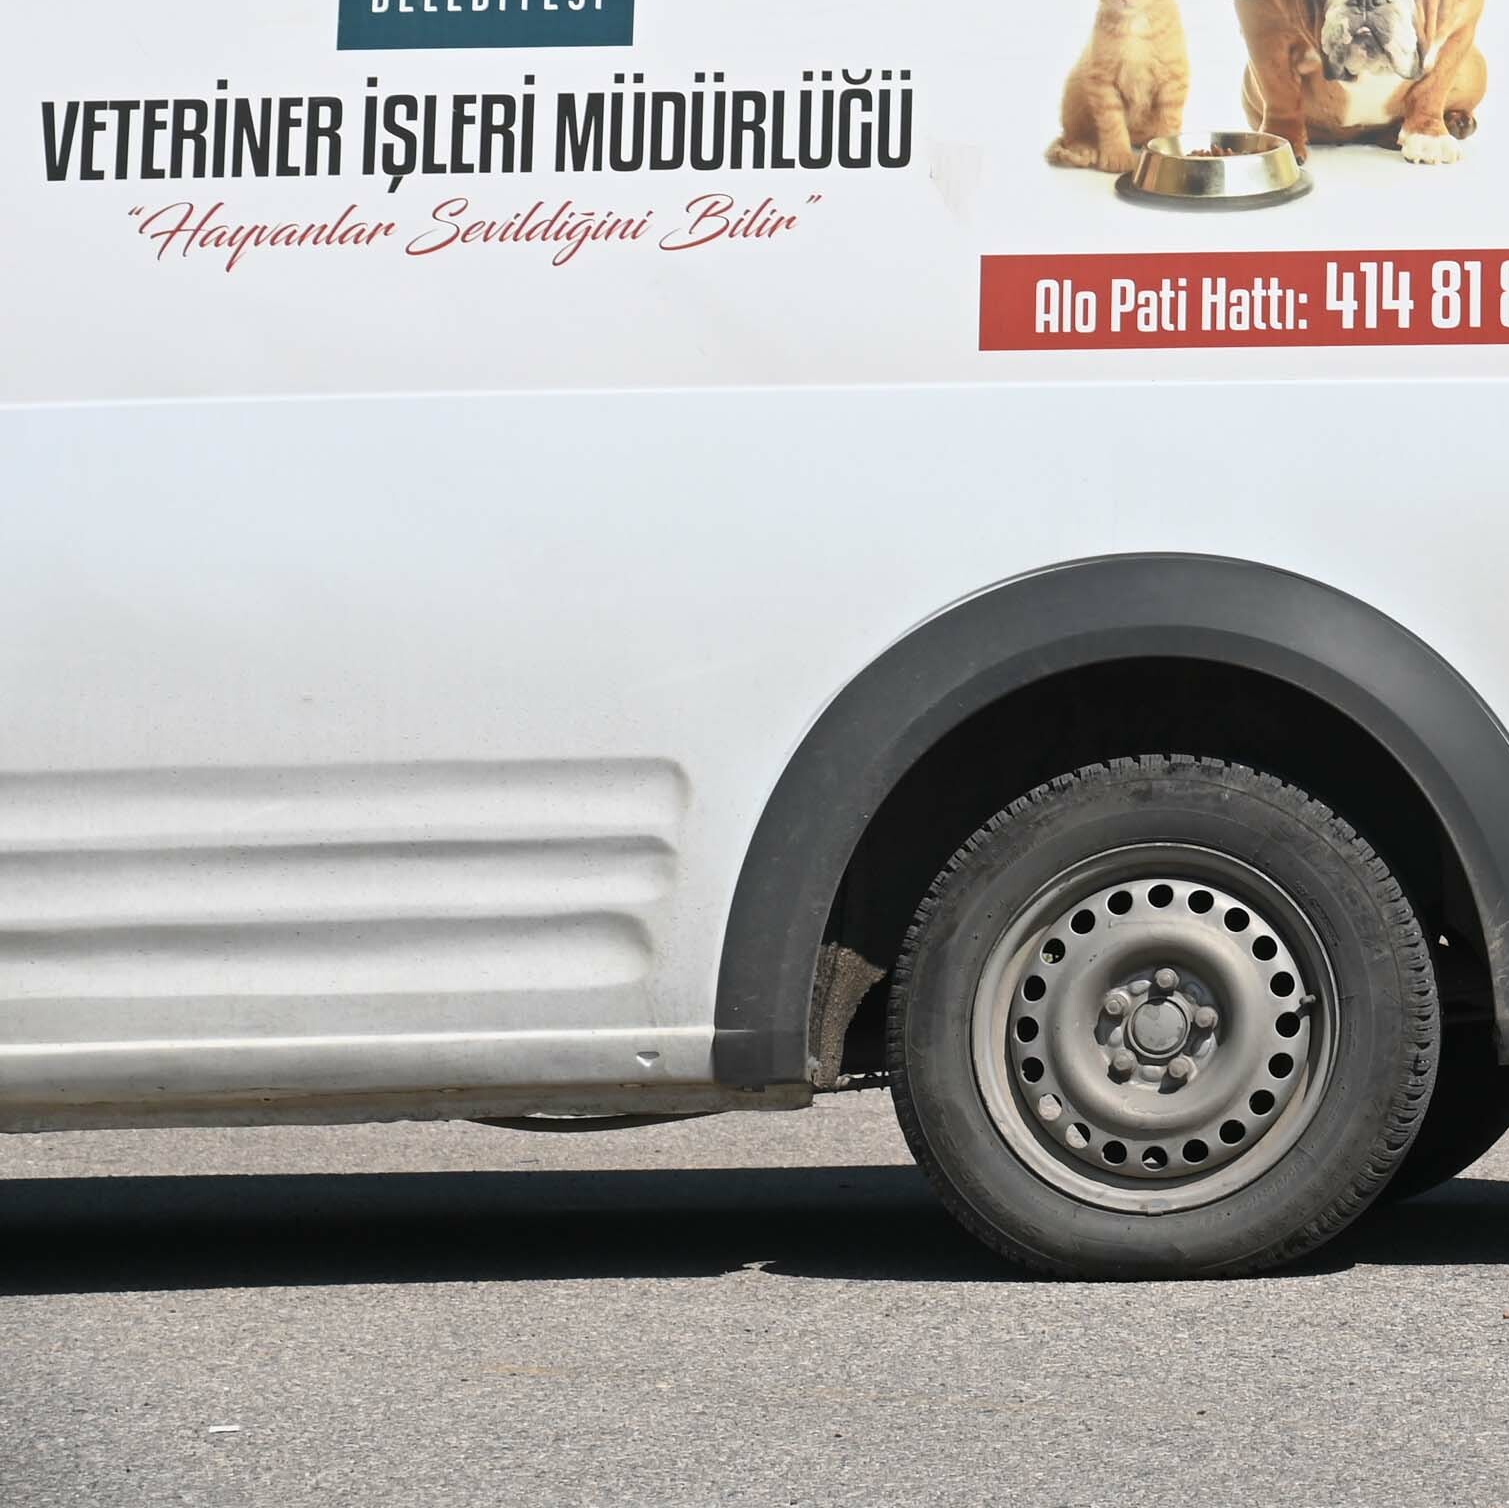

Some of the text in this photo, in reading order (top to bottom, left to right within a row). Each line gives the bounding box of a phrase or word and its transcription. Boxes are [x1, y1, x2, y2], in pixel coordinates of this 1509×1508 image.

[41, 68, 914, 194] VETERİNER İŞLERİ MÜDÜRLÜĞÜ
[405, 197, 653, 267] Sevildiğini
[1034, 278, 1098, 334] Alo
[1110, 277, 1189, 333] Pati
[1201, 277, 1309, 331] Hattı:
[1325, 261, 1415, 330] 414
[1431, 260, 1483, 329] 81
